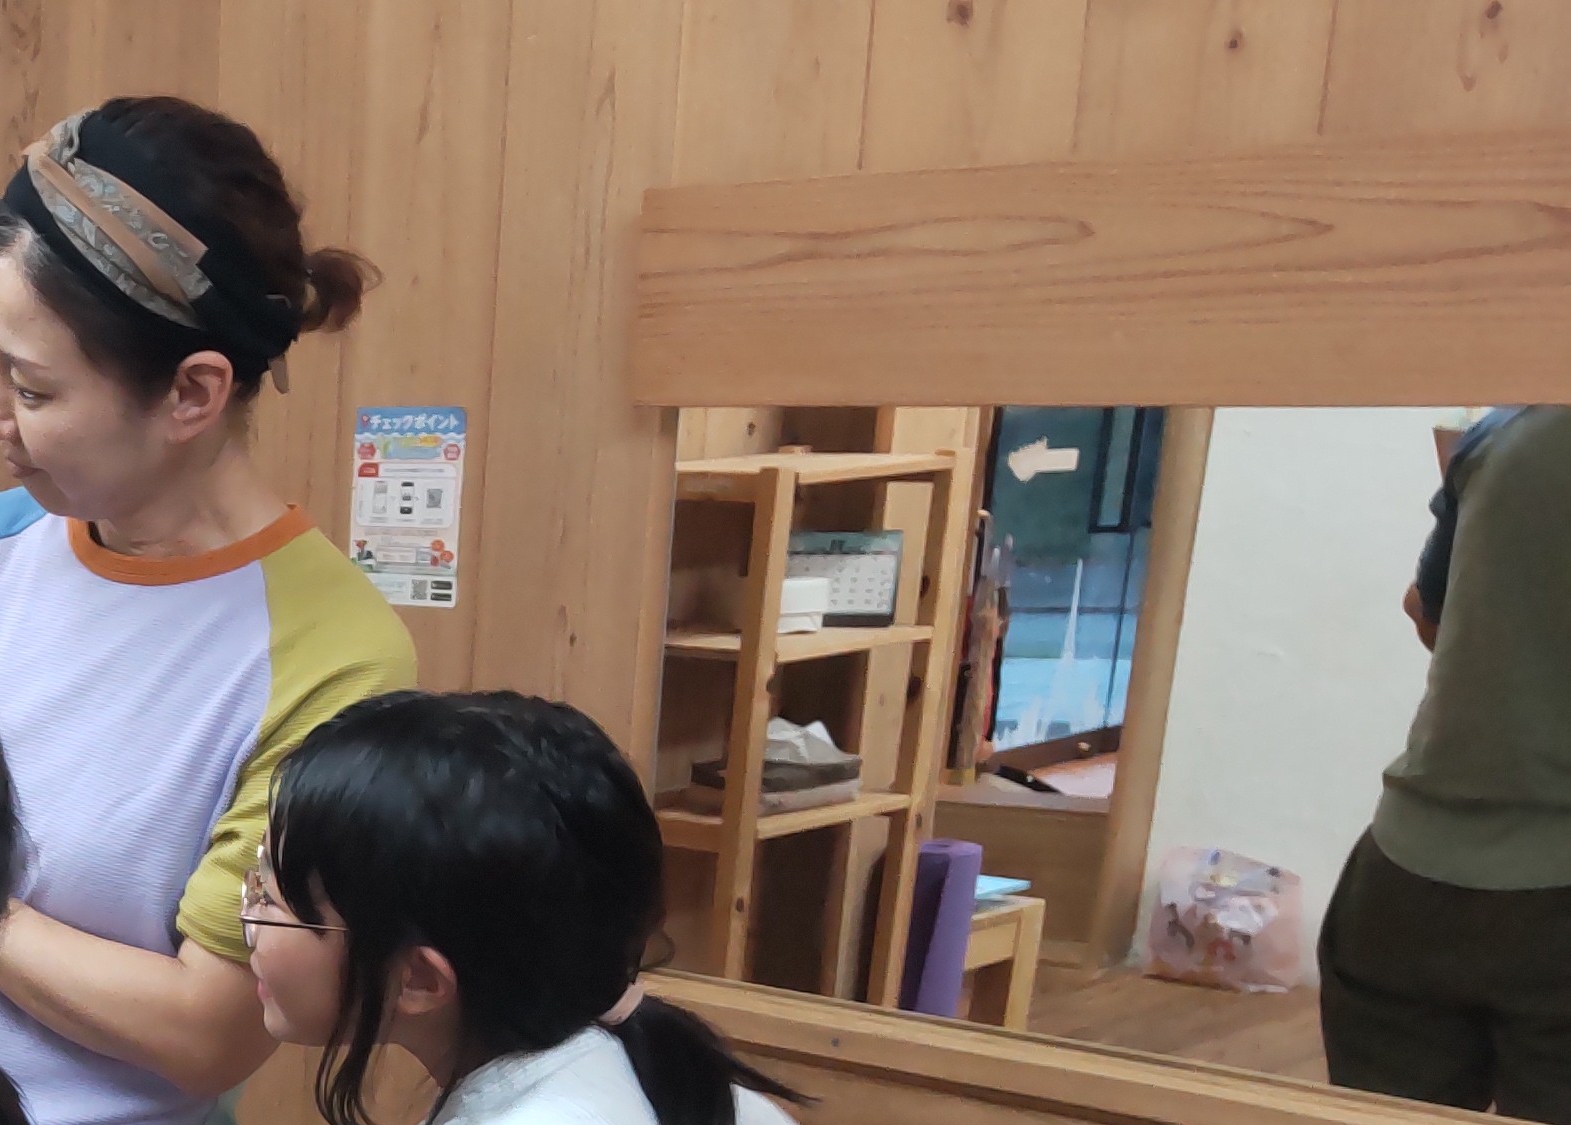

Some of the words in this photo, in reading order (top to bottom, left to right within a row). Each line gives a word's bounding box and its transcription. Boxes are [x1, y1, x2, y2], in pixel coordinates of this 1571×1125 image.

[369, 414, 459, 430] チェックポイント
